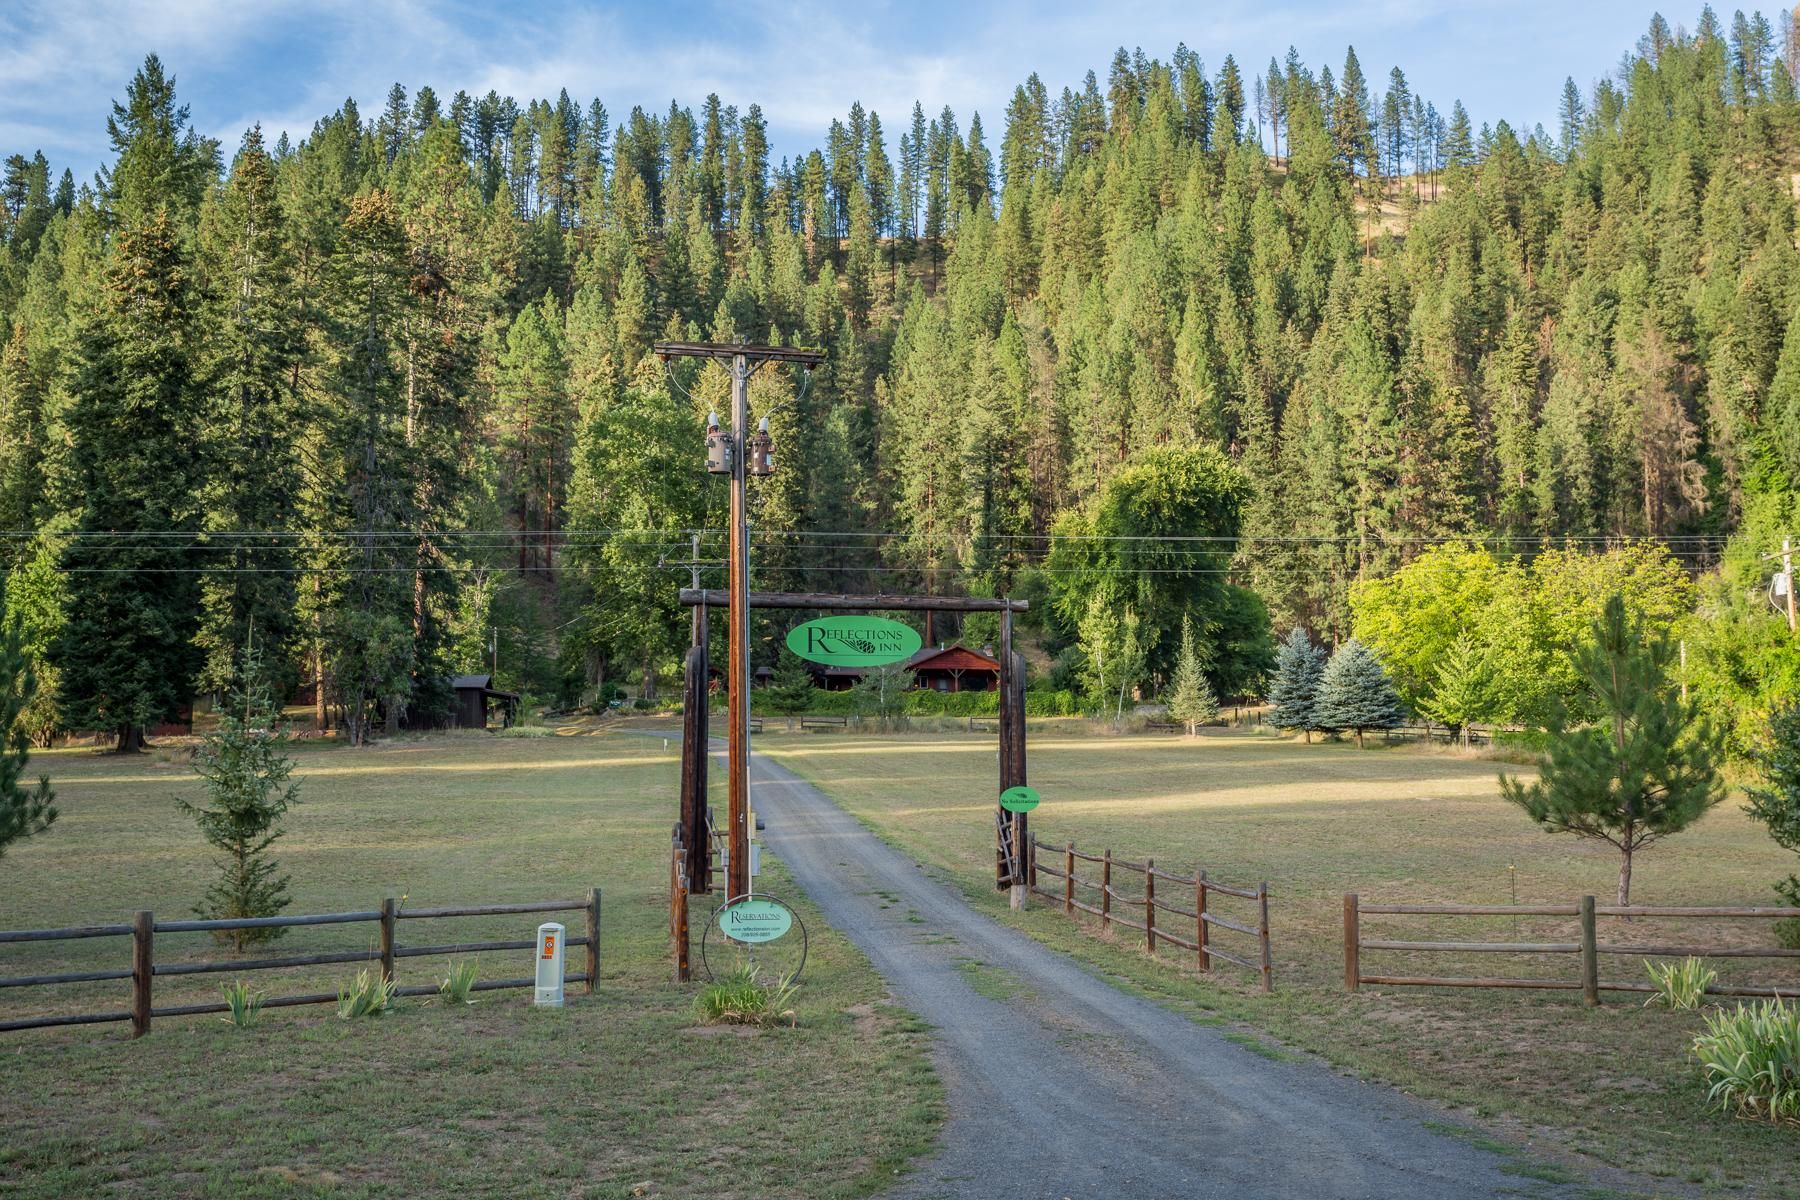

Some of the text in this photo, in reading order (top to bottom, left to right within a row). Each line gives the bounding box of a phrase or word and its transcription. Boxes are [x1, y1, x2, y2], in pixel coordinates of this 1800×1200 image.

[807, 626, 903, 654] REFLECTIONS
[879, 643, 902, 652] INN
[731, 910, 782, 924] RESERVATIONS
